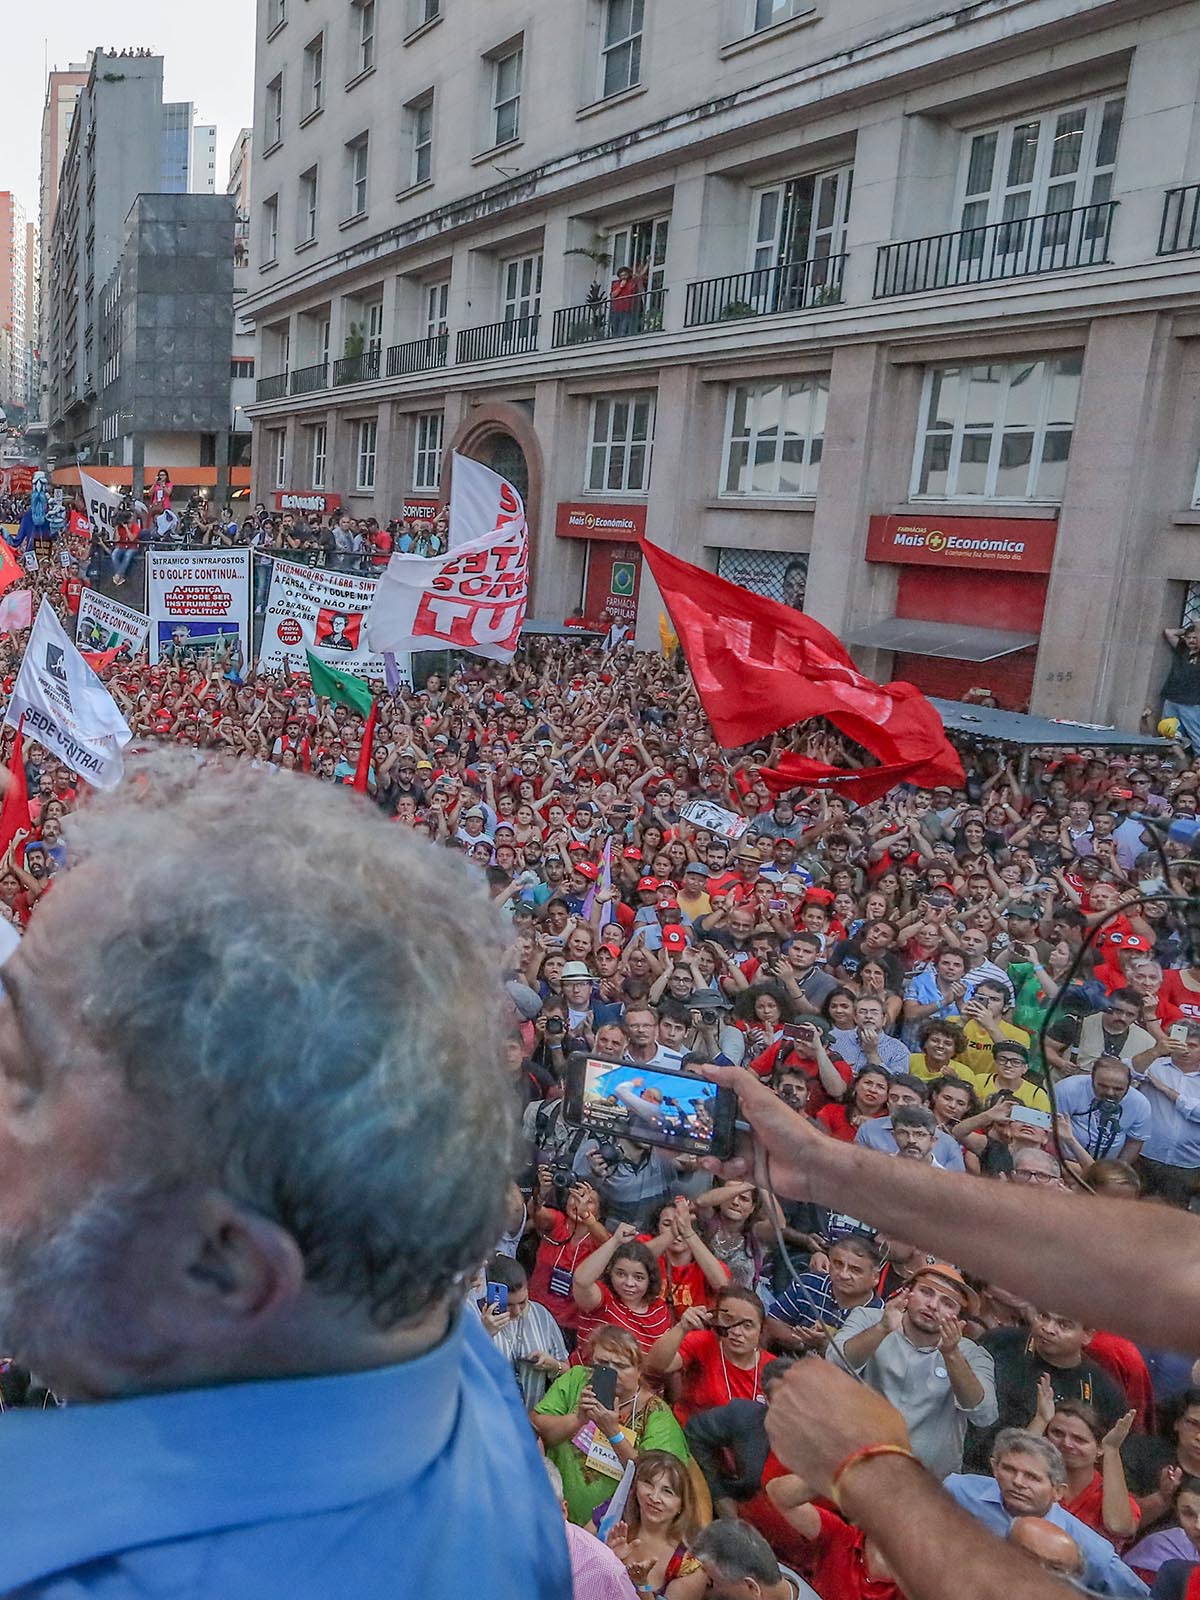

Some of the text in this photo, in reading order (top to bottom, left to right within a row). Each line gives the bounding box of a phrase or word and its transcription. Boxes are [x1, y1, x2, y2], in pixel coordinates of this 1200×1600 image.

[403, 505, 436, 519] SORVETES
[569, 516, 585, 526] Mais
[894, 533, 924, 547] Mais
[192, 557, 245, 565] SINTRAPOSTOS
[152, 569, 158, 580] E
[159, 569, 165, 580] O
[167, 569, 193, 580] GOLPE
[274, 575, 280, 584] A
[329, 587, 355, 599] GOLPE
[294, 591, 321, 604] POVO
[277, 599, 312, 613] O BRASIL
[605, 607, 635, 619] POPULAR
[268, 606, 316, 622] QUER SABER
[25, 707, 57, 736] SEDE
